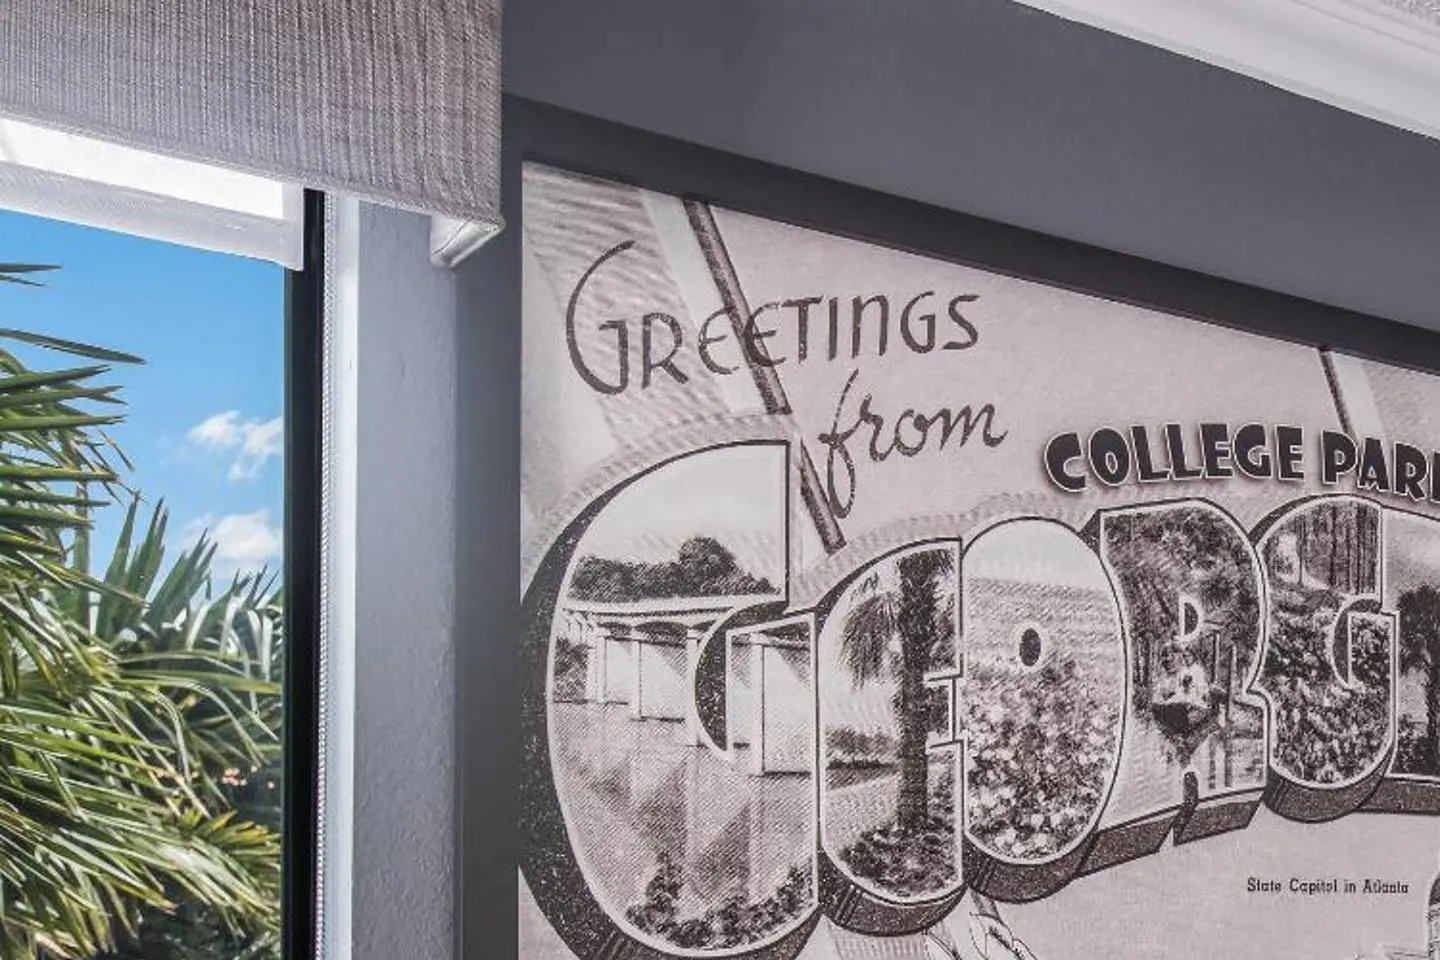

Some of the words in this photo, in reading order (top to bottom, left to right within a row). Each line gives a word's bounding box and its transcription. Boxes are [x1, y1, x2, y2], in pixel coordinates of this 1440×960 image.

[566, 240, 981, 396] GREETINGS
[818, 368, 1007, 519] from
[1044, 423, 1304, 493] COLLEGE
[1247, 876, 1282, 893] State
[1289, 877, 1337, 895] Capitol
[1344, 879, 1356, 893] in
[1363, 878, 1409, 894] Atlanta
